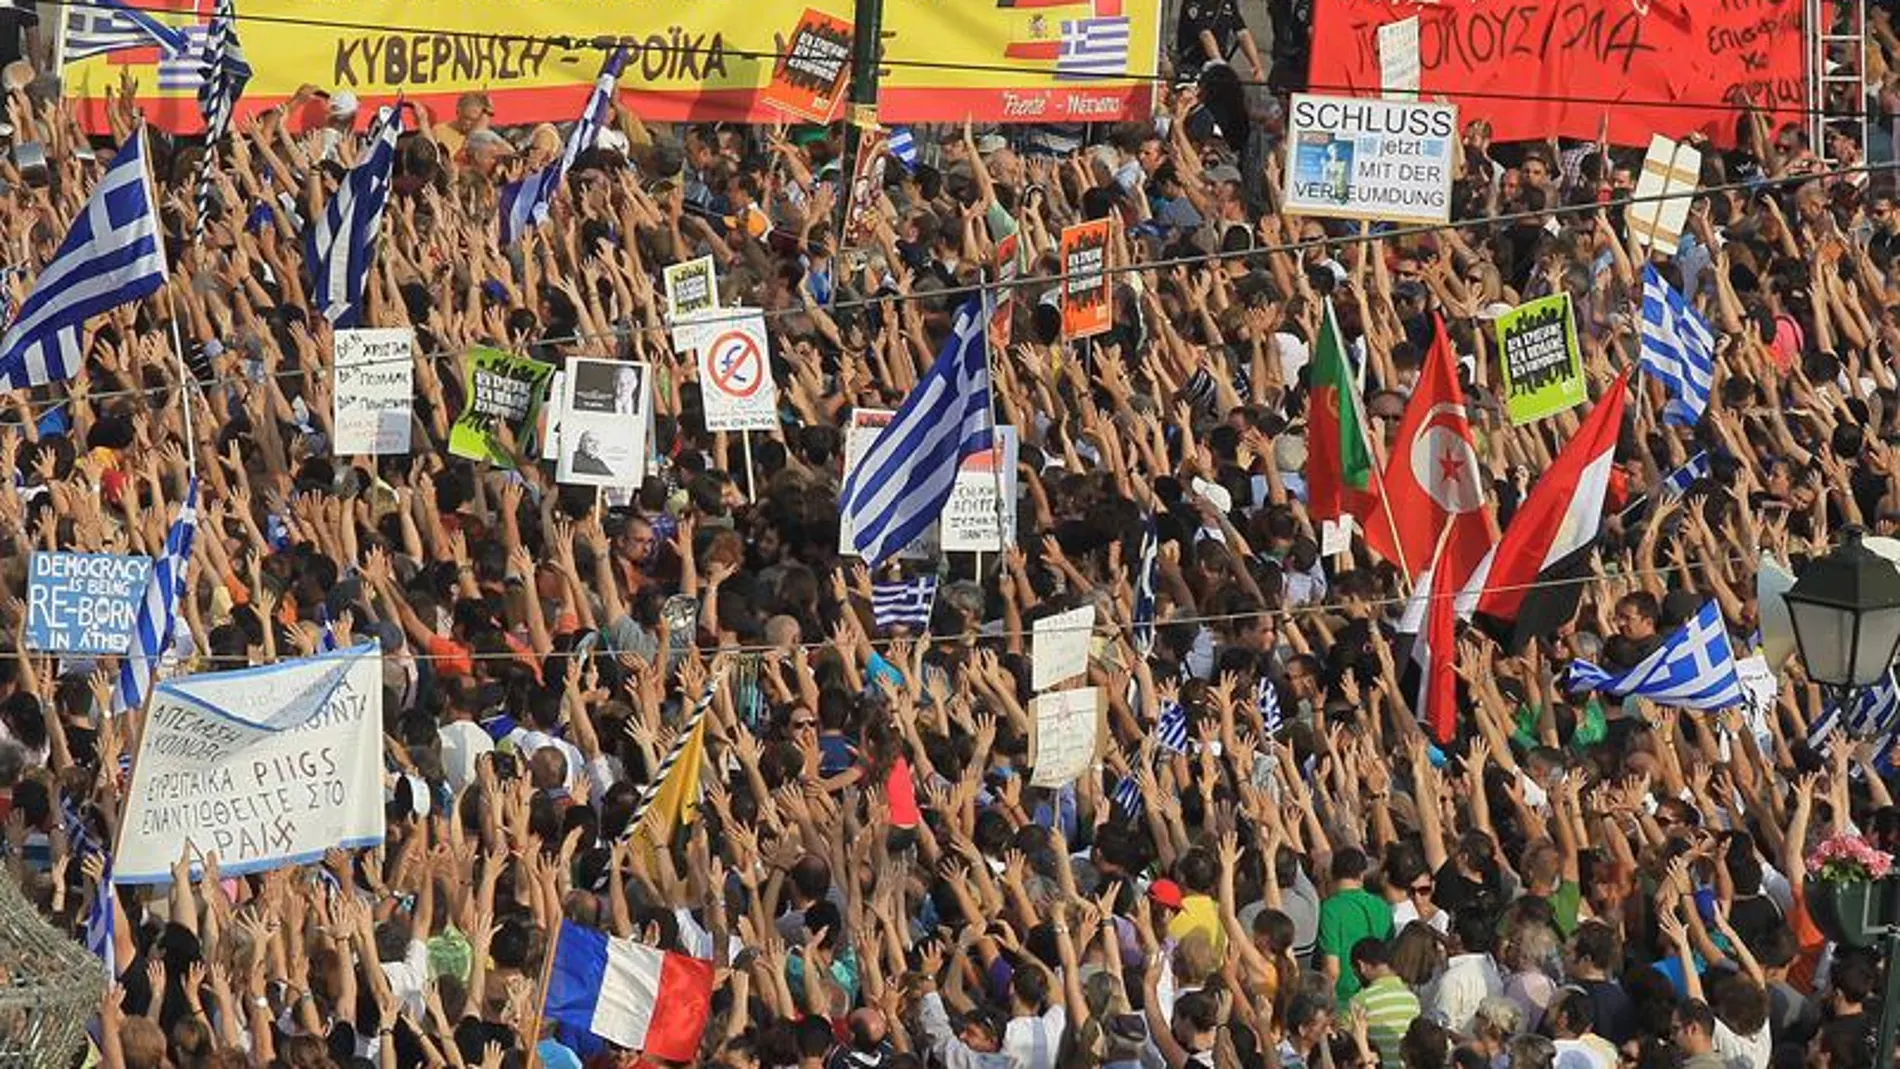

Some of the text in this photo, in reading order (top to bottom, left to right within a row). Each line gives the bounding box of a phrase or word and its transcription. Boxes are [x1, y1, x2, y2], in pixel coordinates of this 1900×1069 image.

[335, 34, 549, 86] ΚΥΒΕΡΝΗΣΗ
[1295, 102, 1452, 137] SCHLUSS
[1380, 139, 1422, 157] jetzt
[1359, 162, 1441, 182] MIT DER
[37, 554, 148, 580] DEMOCRACY
[69, 577, 131, 597] IS BEING
[29, 583, 136, 630] RE-BORN
[49, 630, 70, 650] IN
[253, 747, 338, 787] PIIGS
[307, 778, 346, 810] ΣΤΟ
